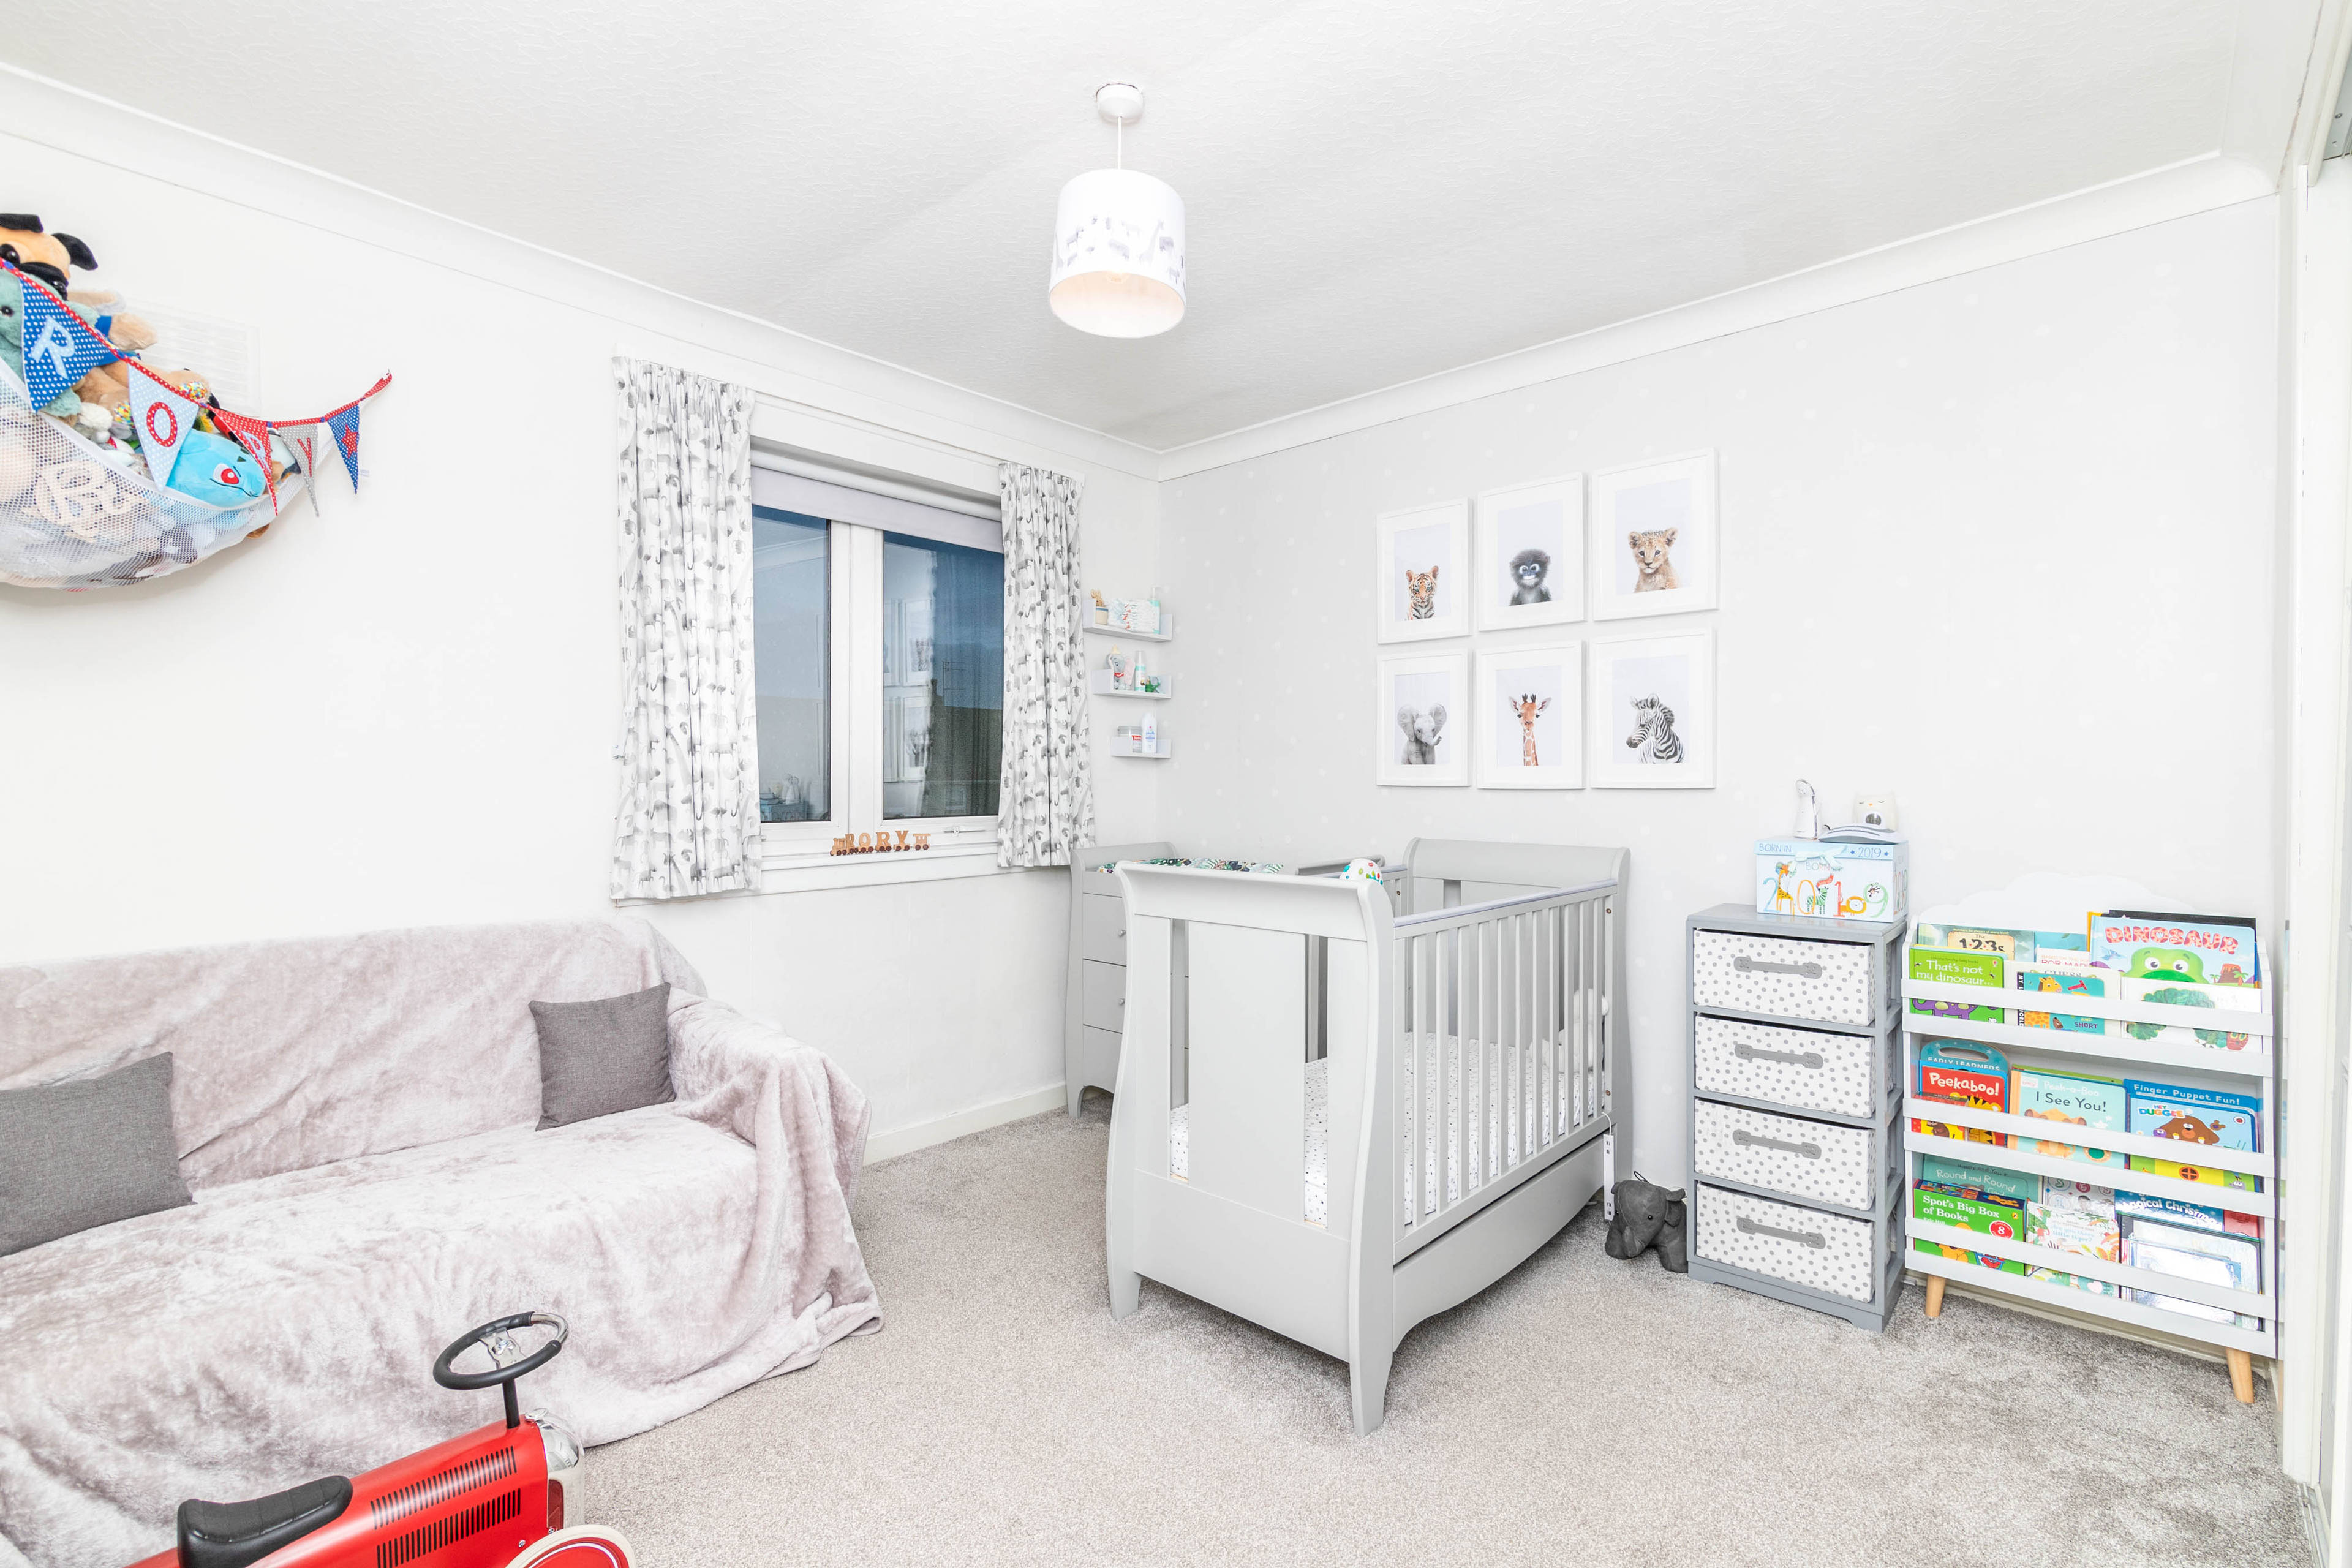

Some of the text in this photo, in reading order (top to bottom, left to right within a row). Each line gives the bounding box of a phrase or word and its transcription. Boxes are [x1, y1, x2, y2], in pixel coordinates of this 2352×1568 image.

[1759, 843, 1882, 858] BORN IN 2019
[2104, 925, 2239, 954] DINOSAUR
[1916, 971, 1933, 981] my
[1926, 960, 1983, 974] That's not
[1929, 1072, 2000, 1096] Peekaboo!
[2036, 1091, 2106, 1112] I See You!
[2133, 1084, 2240, 1105] Finger Puppet Fun!
[2138, 1107, 2185, 1118] DUGGEE
[1936, 1169, 1967, 1180] Round
[1983, 1175, 2016, 1193] Round
[1923, 1195, 2000, 1219] Spot's Big Box
[1936, 1208, 1969, 1223] Books
[1997, 1226, 2005, 1235] 8
